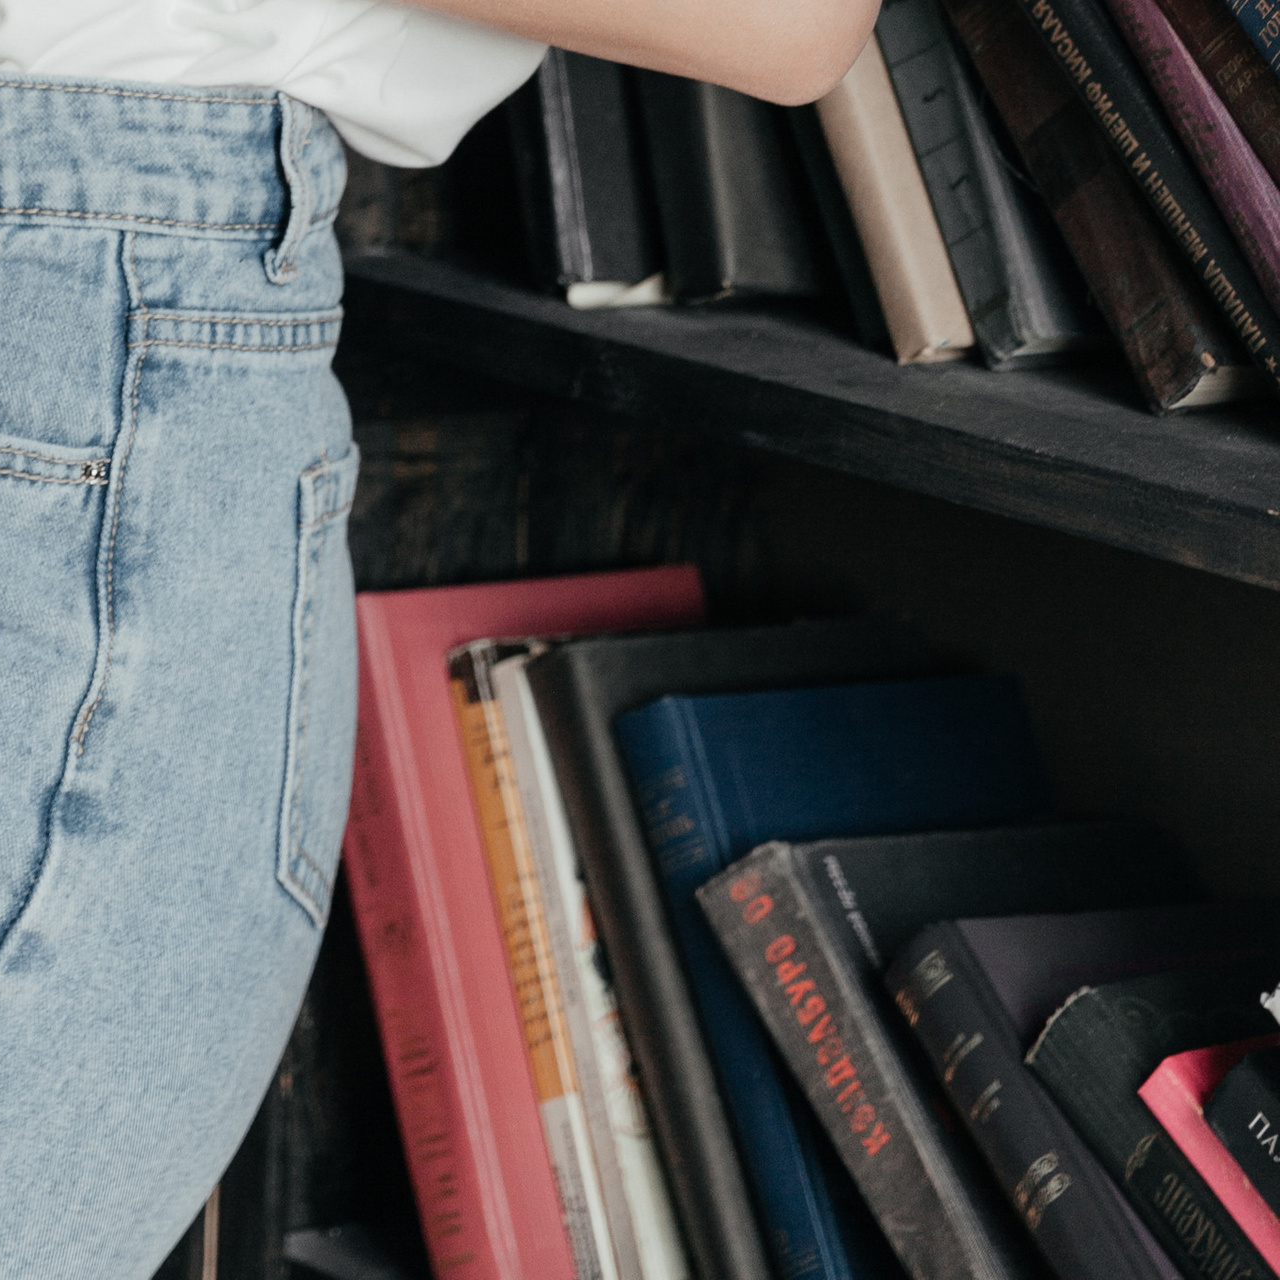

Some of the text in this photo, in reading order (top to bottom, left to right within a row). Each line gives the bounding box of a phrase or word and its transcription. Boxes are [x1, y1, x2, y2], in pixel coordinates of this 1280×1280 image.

[1086, 81, 1139, 156] ШЕРИФ
[1130, 151, 1152, 174] И
[1147, 170, 1208, 262] МЕНШЕН
[1203, 258, 1266, 352] ПАПАША
